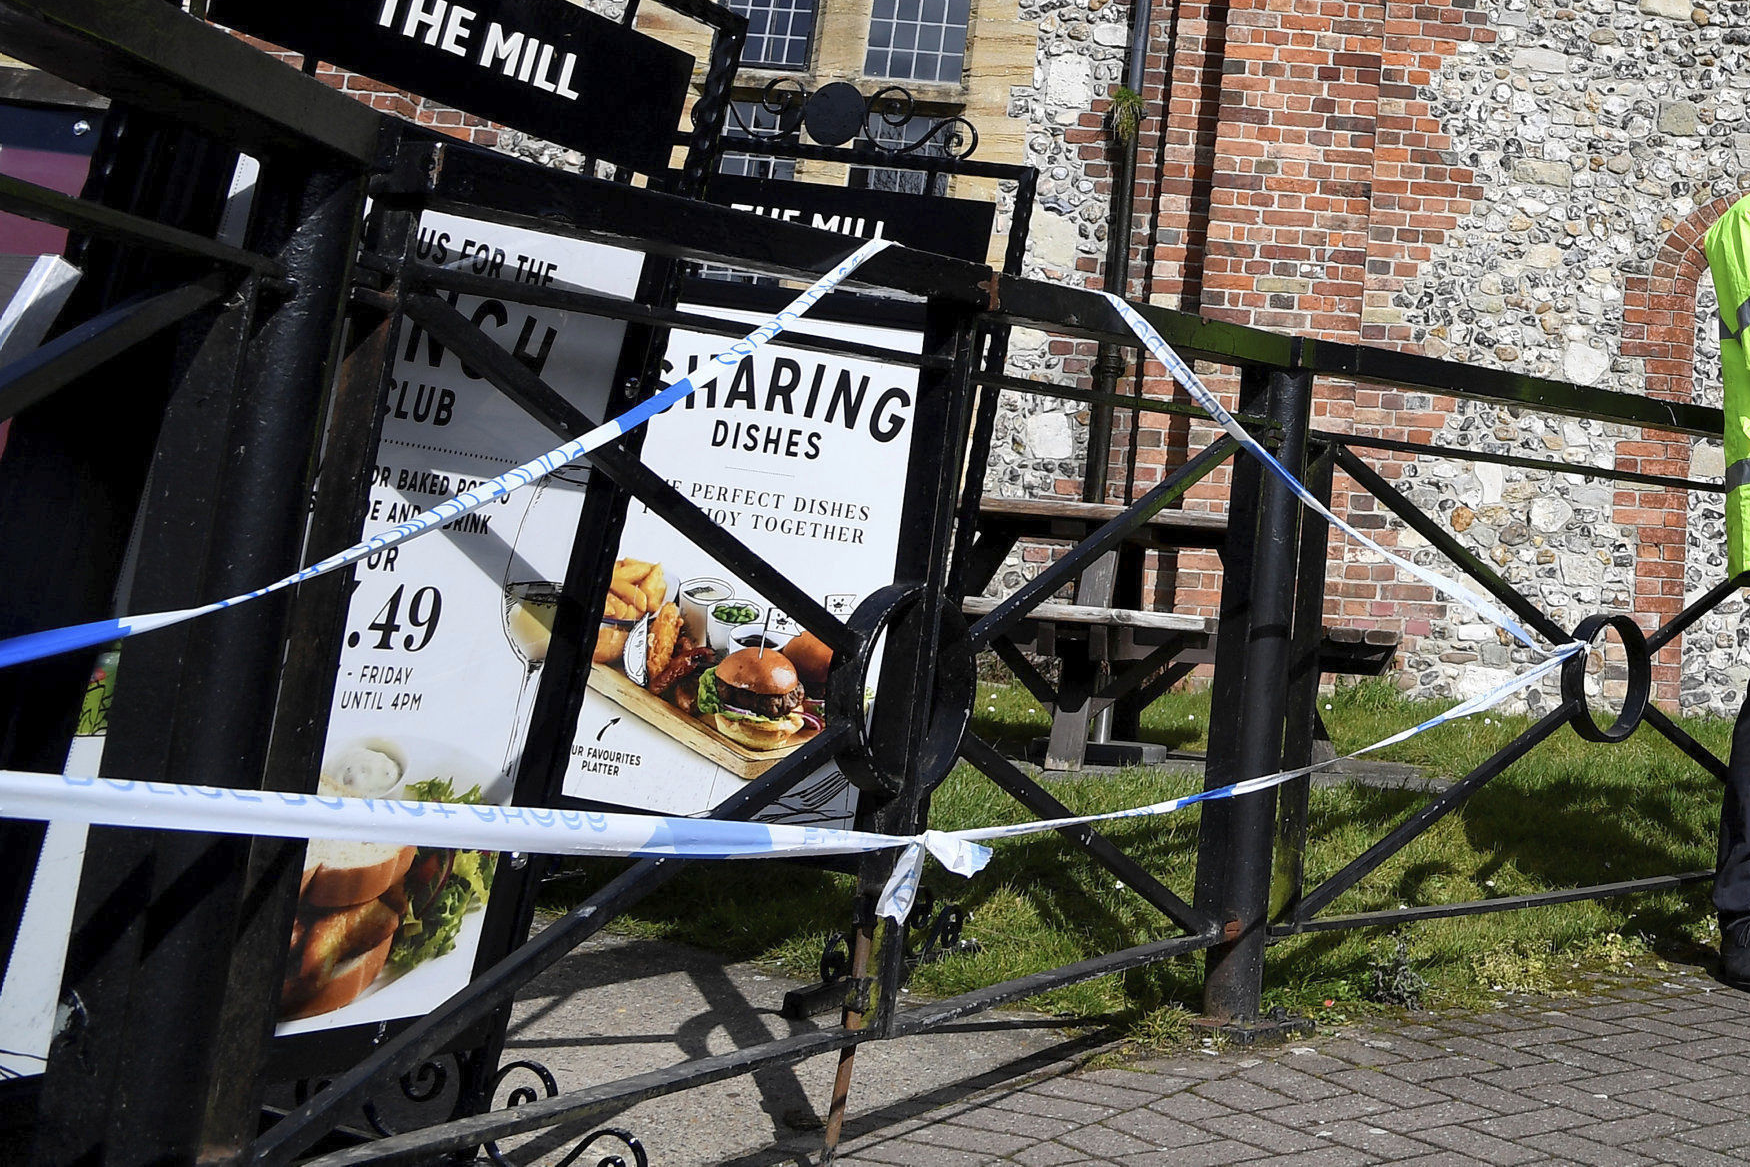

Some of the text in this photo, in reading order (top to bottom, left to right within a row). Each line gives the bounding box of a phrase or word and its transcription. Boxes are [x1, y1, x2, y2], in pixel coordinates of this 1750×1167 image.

[478, 21, 580, 101] MILL
[415, 226, 451, 265] US
[457, 239, 506, 279] FOR
[711, 419, 822, 460] DISHES
[399, 468, 448, 496] BAKED
[691, 482, 785, 510] PERFECT
[793, 495, 871, 522] DISHES
[752, 513, 865, 545] TOGETHER
[359, 664, 414, 686] FRIDAY
[340, 690, 423, 711] UNTIL 4PM
[581, 759, 620, 777] PLATTER
[586, 746, 642, 767] FAVOURITES
